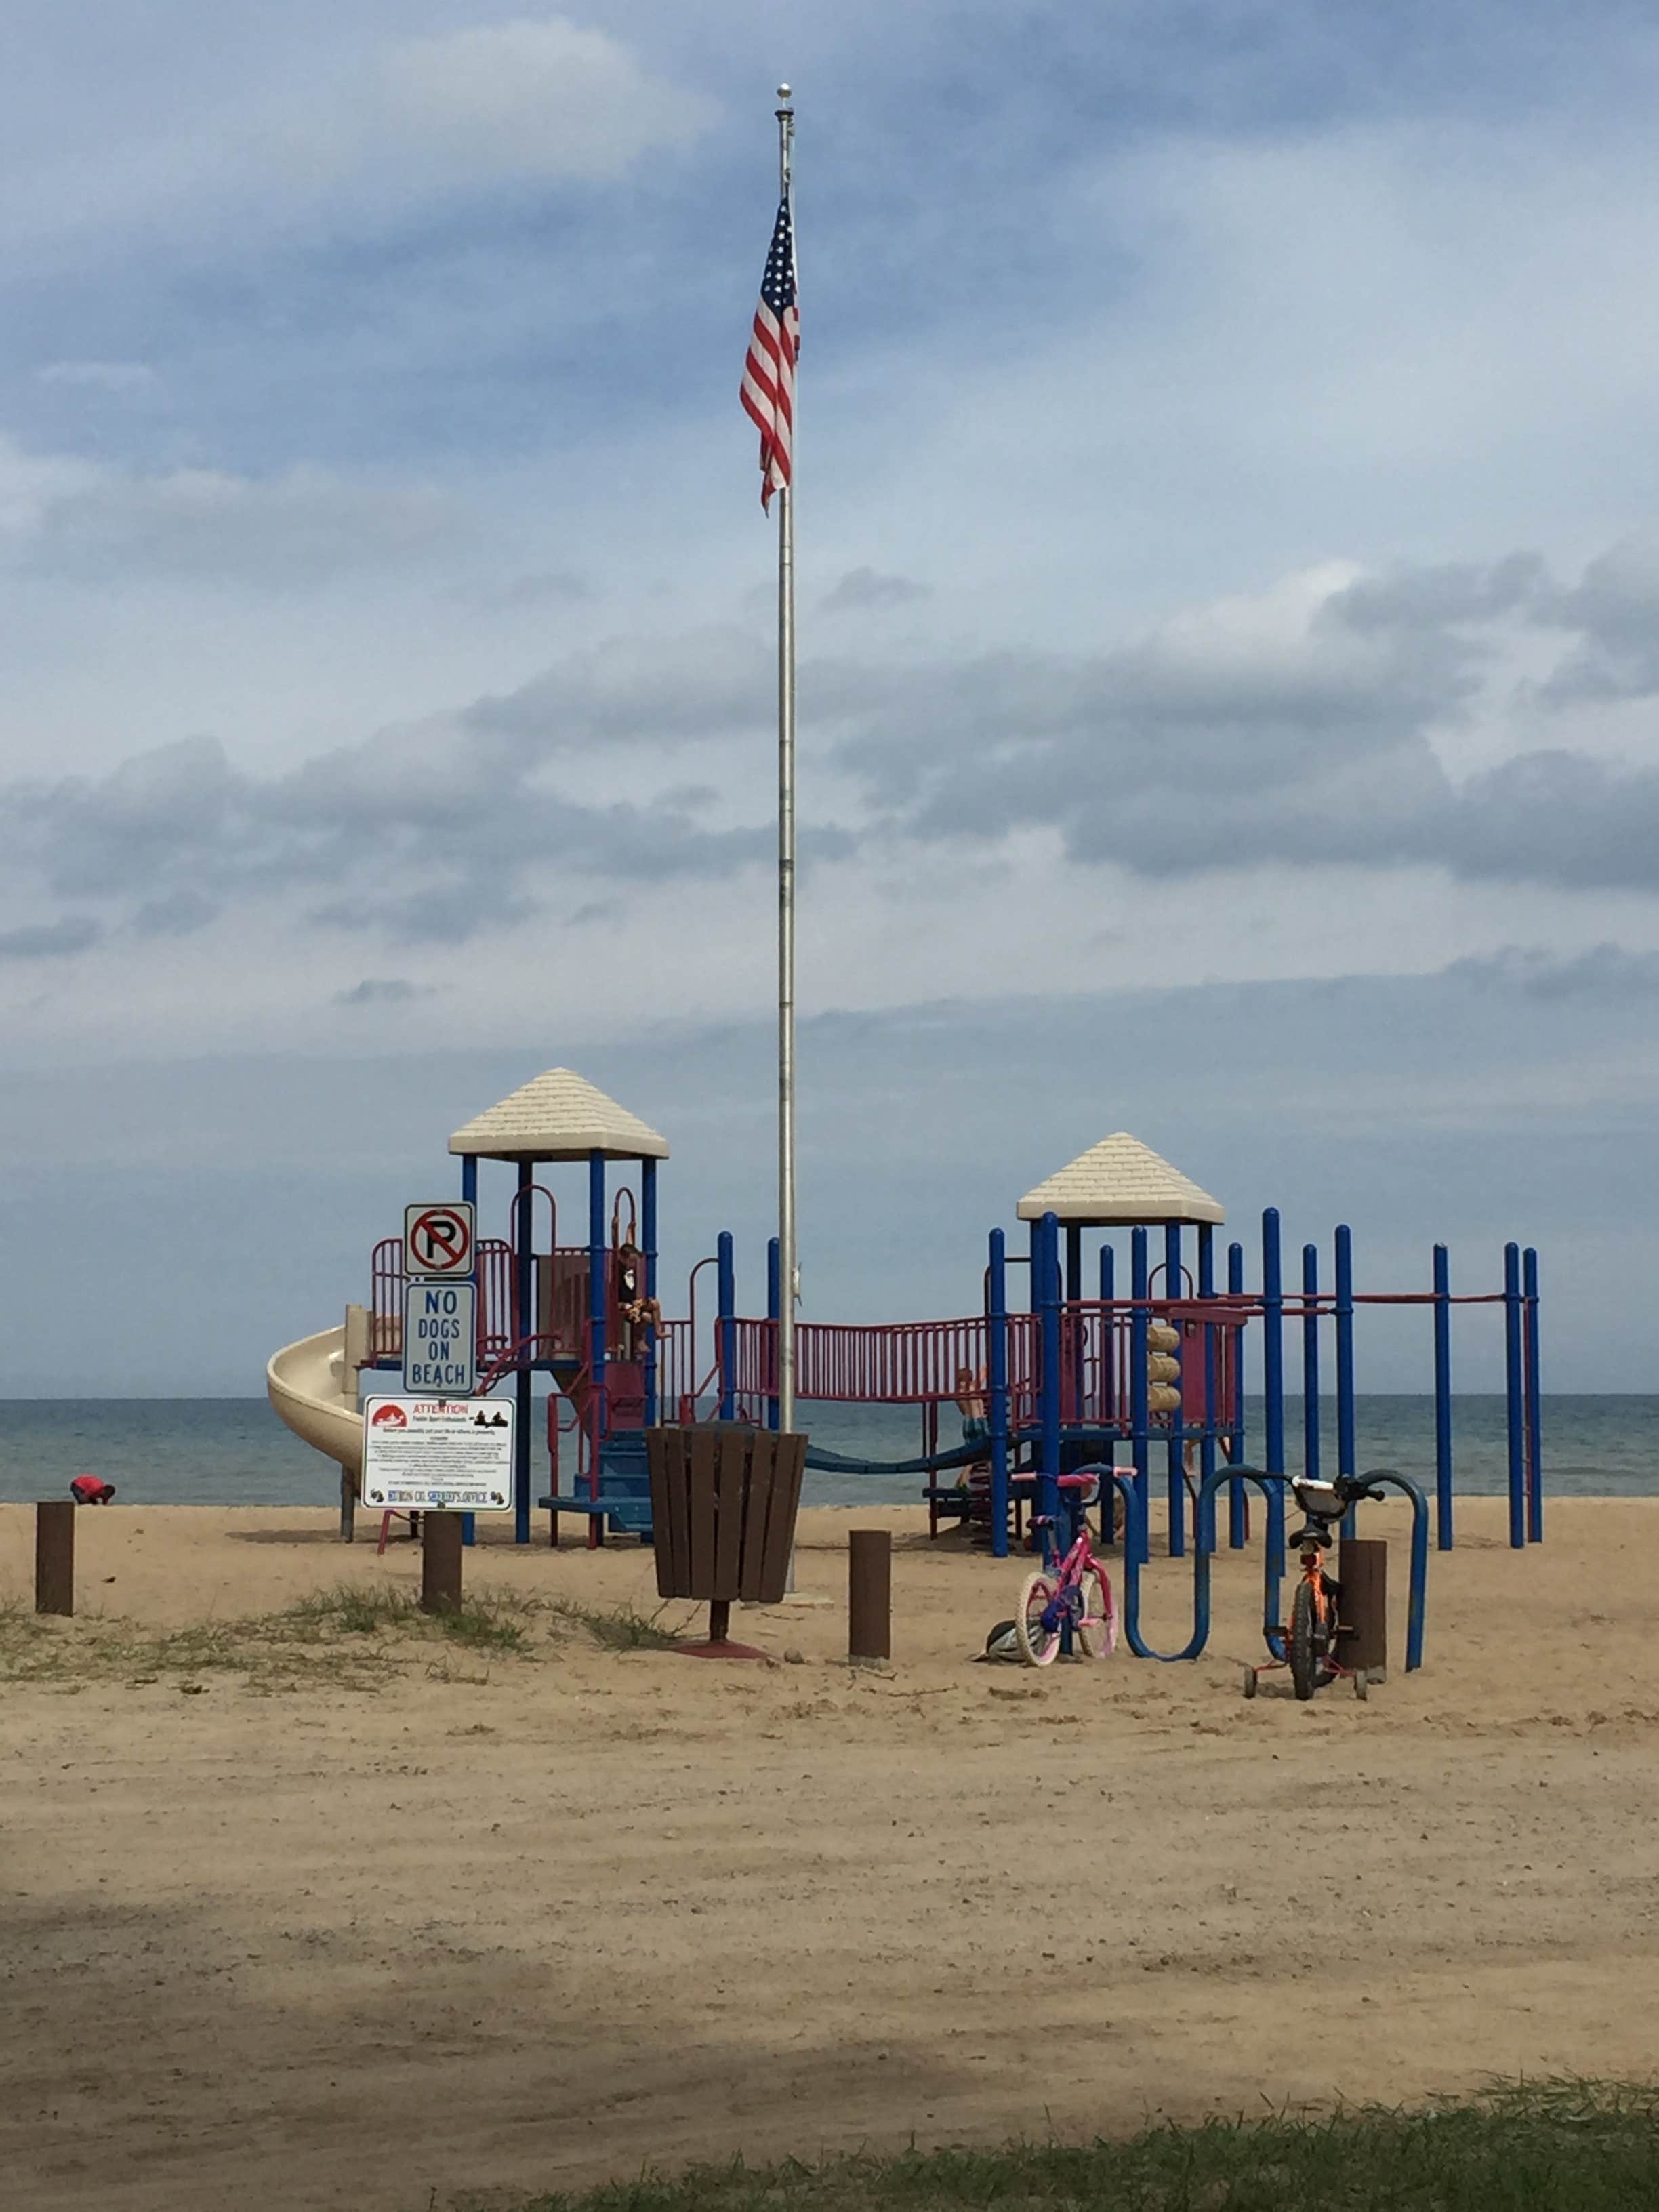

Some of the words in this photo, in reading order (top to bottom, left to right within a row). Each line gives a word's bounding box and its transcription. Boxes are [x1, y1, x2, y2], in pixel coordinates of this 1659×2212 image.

[425, 1290, 457, 1314] NO
[418, 1318, 460, 1338] DOGS
[428, 1340, 449, 1361] ON
[412, 1364, 465, 1385] BEACH
[412, 1404, 469, 1414] ATTENTION
